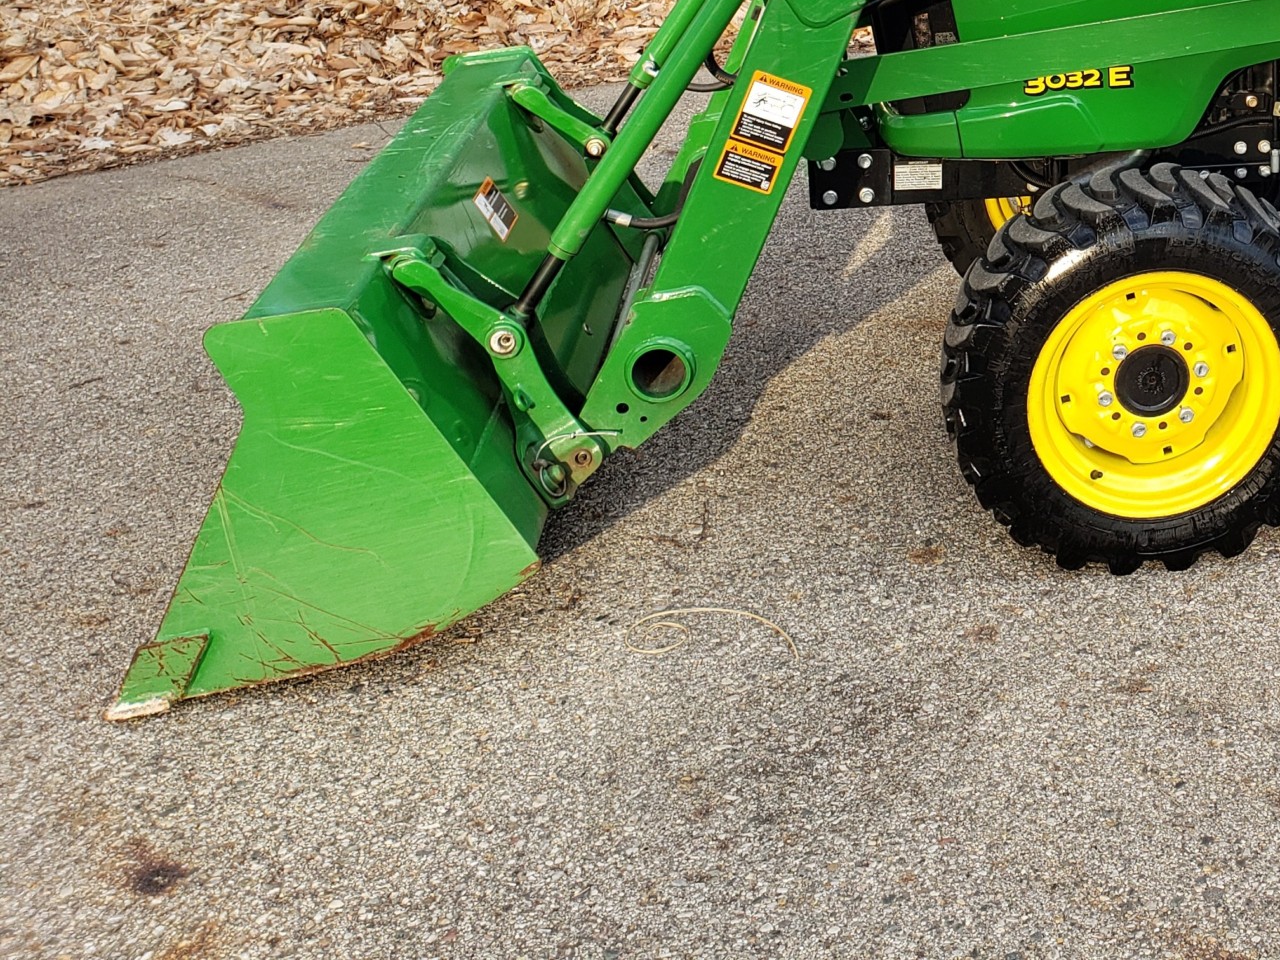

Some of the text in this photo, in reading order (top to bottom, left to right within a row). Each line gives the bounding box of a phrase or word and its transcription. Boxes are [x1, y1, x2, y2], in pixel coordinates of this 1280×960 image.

[768, 77, 804, 96] WARNING
[1023, 65, 1135, 97] 3032 E
[741, 147, 776, 164] WARNING
